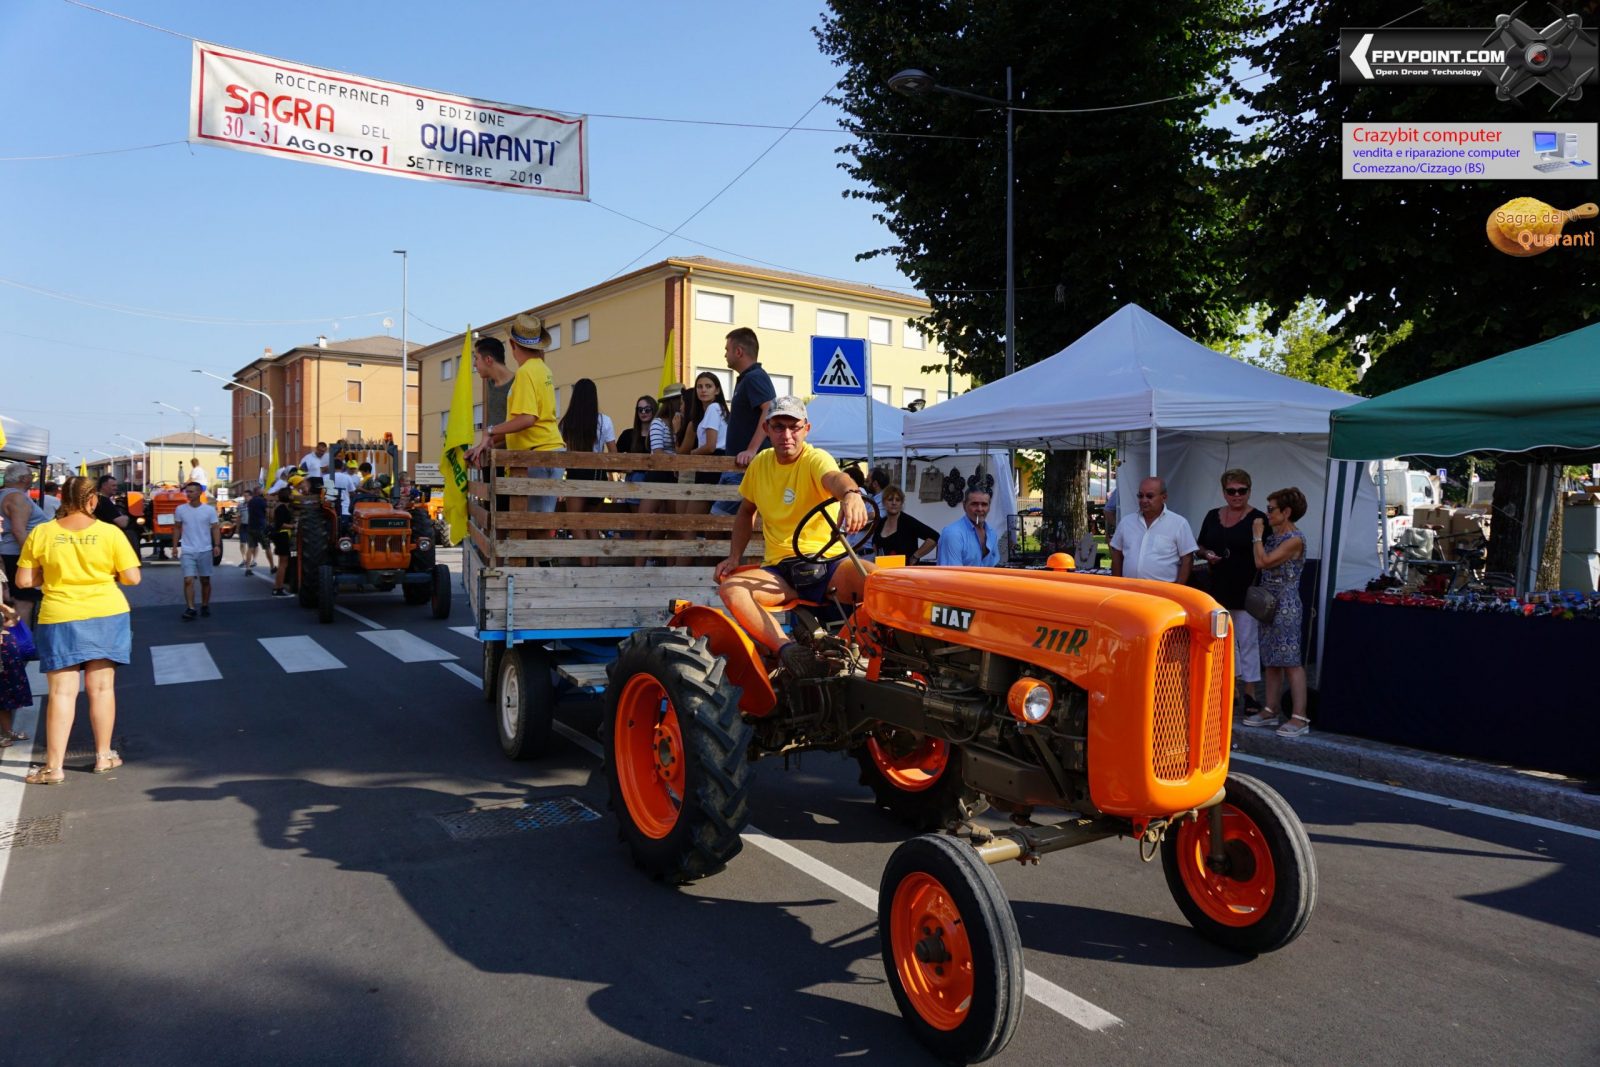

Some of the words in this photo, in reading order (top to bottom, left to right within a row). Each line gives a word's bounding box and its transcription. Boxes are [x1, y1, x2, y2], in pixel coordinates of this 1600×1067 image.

[224, 84, 335, 132] SAGRA
[361, 125, 390, 139] DEL
[275, 73, 389, 106] ROCCAFRANCA
[416, 99, 424, 111] 9
[439, 105, 505, 127] EDIZIONE
[223, 115, 244, 138] 30
[260, 122, 279, 144] 31
[286, 135, 373, 162] AGOSTO
[381, 145, 389, 165] 1
[406, 155, 493, 178] SETTEMBRE
[509, 169, 542, 185] 2019
[931, 606, 971, 629] FIAT
[1032, 625, 1089, 657] 211R
